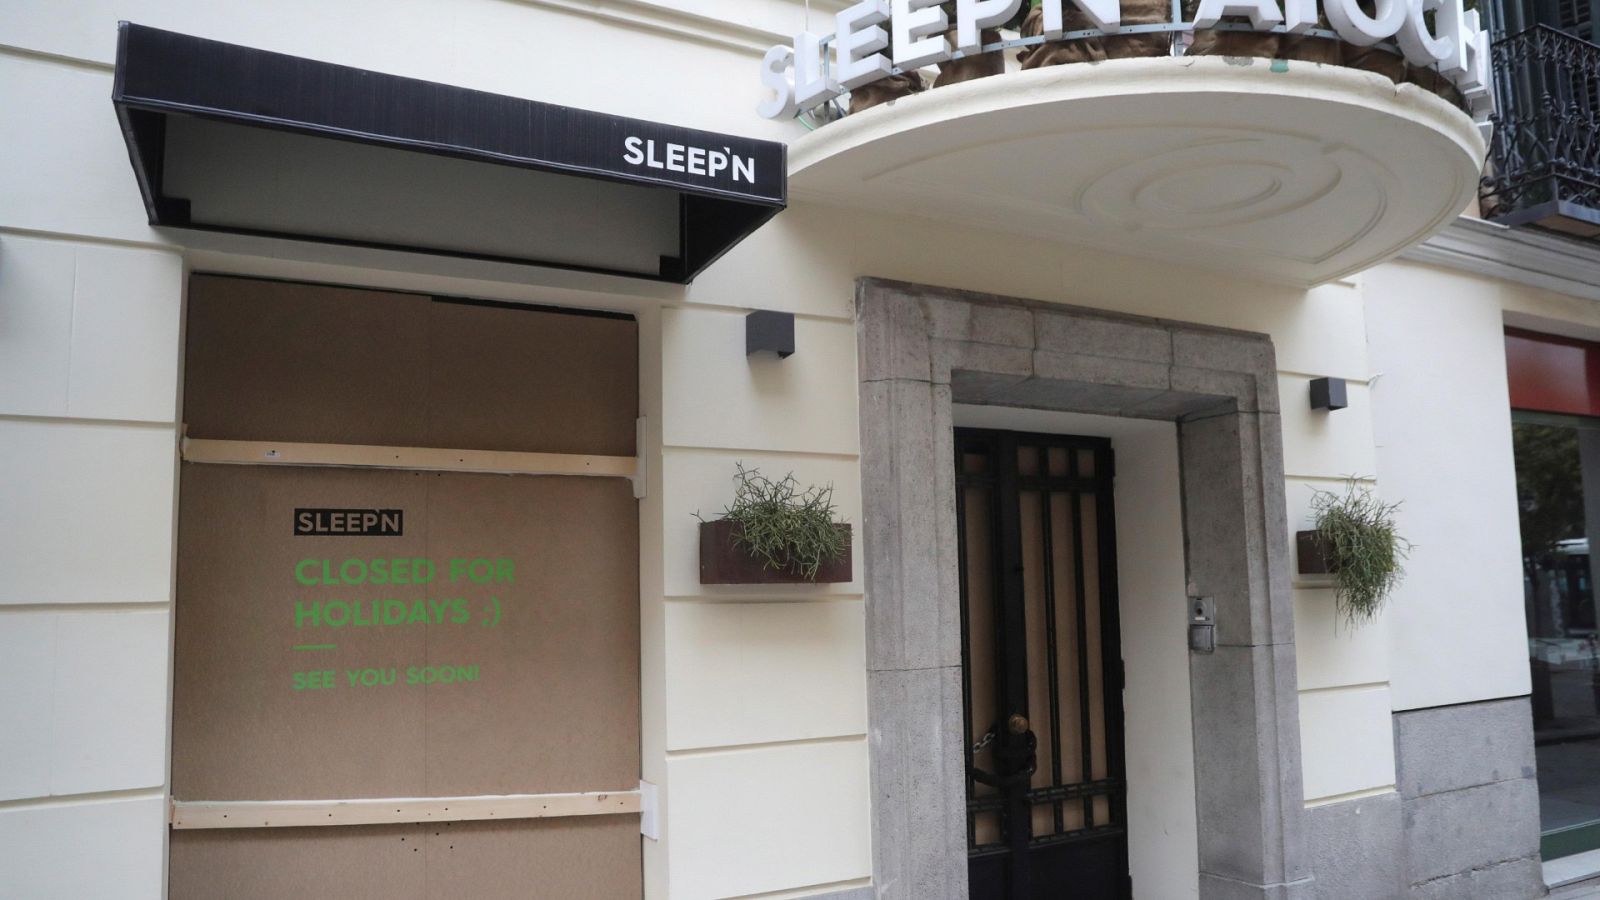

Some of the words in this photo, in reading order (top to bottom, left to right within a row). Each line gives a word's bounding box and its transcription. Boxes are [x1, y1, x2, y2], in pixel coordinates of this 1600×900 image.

[623, 136, 755, 184] SLEEP'N
[295, 558, 436, 586] CLOSED
[451, 557, 516, 585] FOR
[295, 599, 470, 628] HOLIDAYS
[292, 670, 337, 690] SEE
[347, 667, 397, 687] YOU
[405, 664, 481, 686] SOON!
